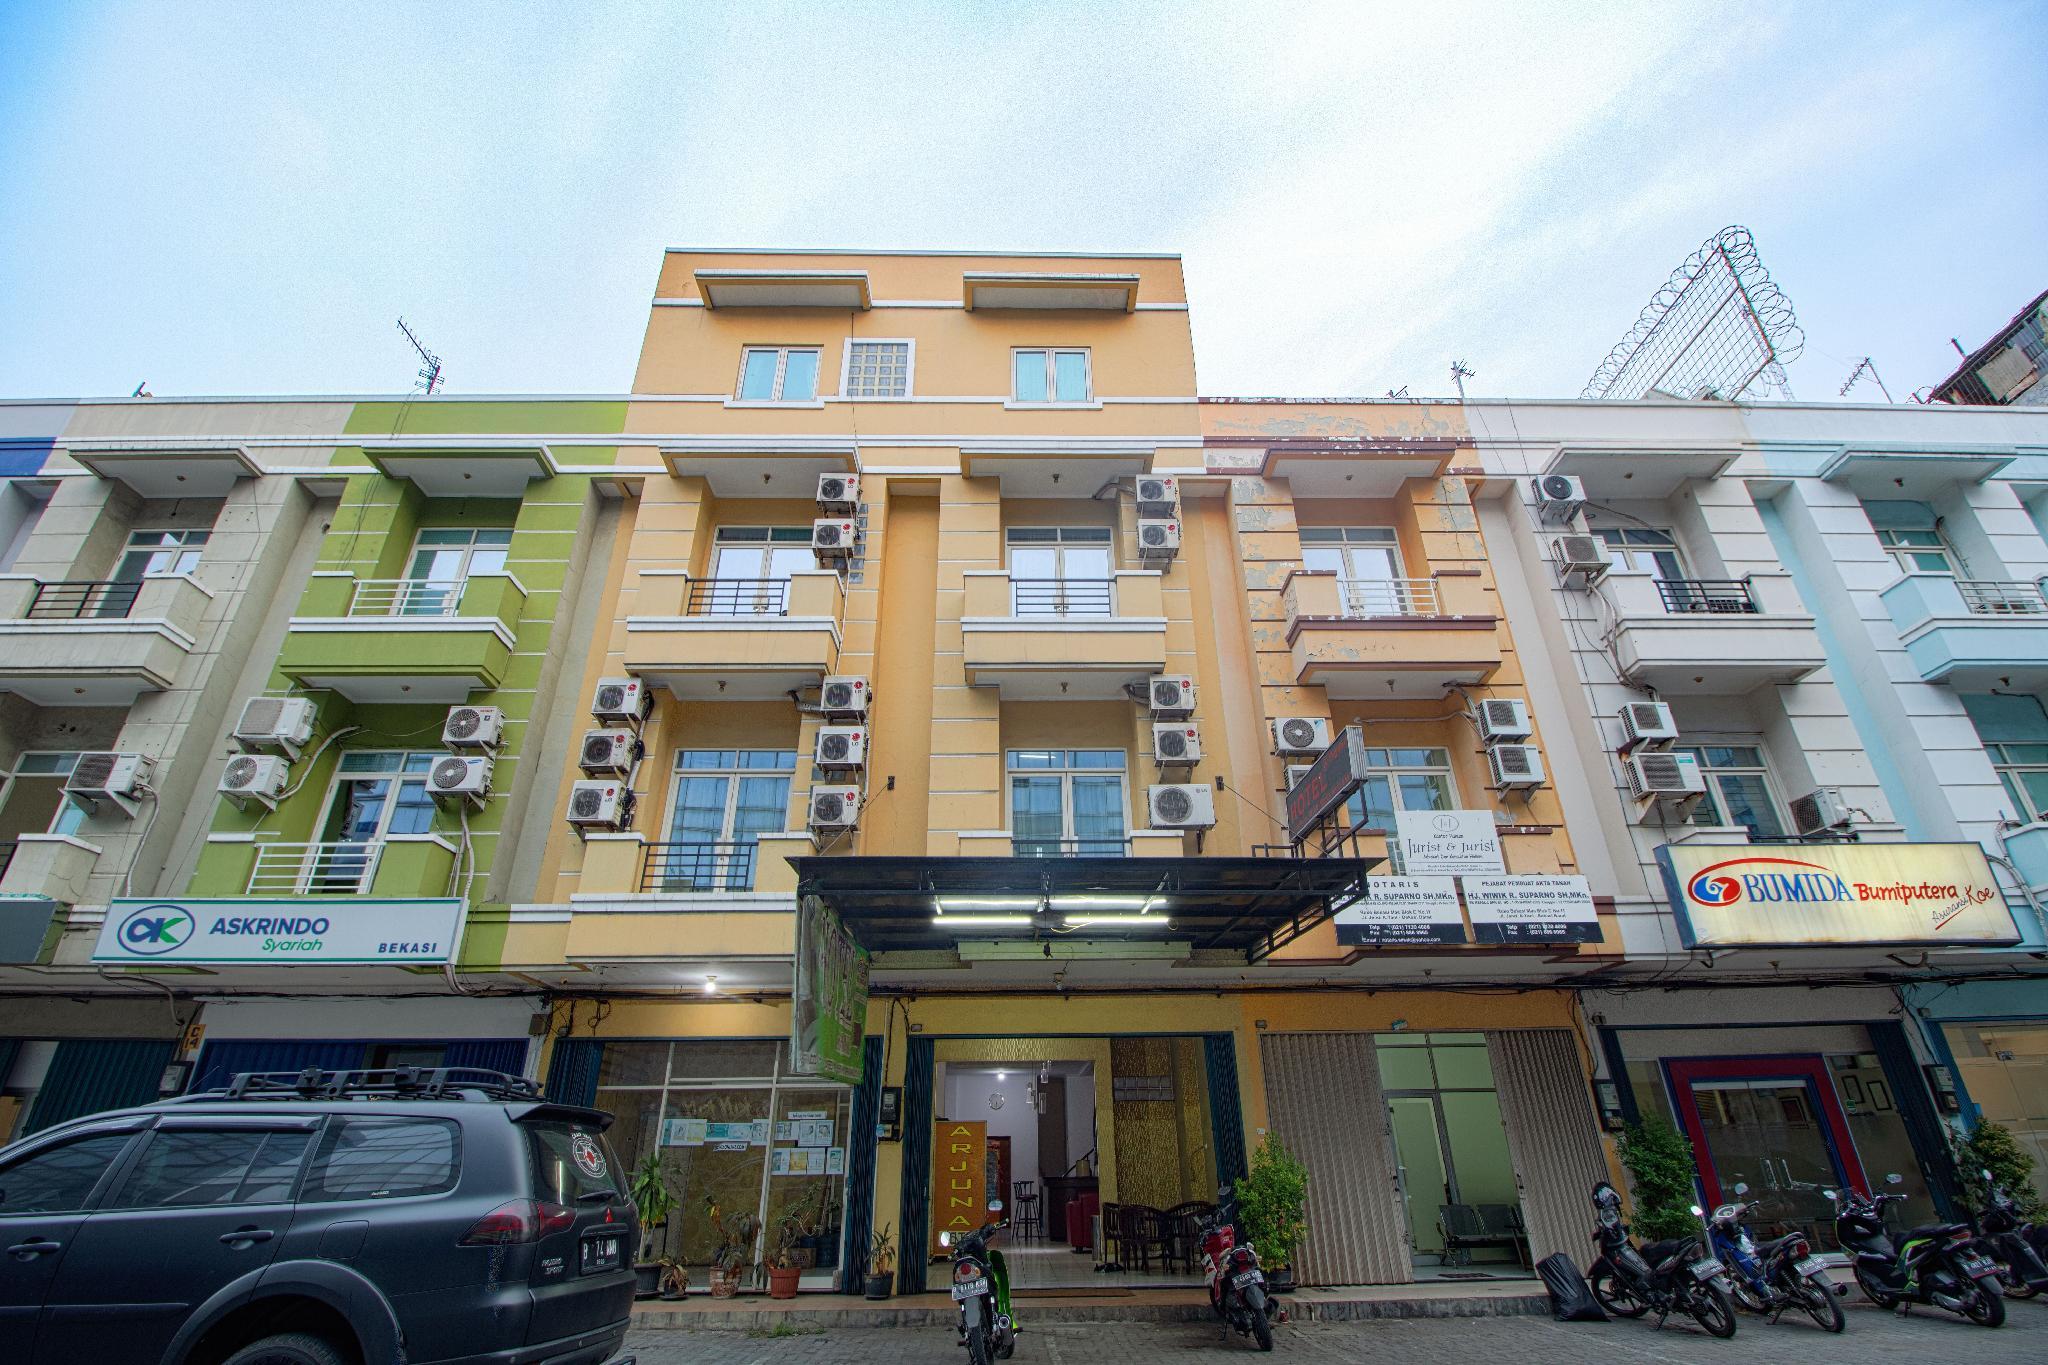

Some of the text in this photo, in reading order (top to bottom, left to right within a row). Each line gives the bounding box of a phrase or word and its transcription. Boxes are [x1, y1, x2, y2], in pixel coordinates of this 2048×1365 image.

[1408, 839, 1441, 858] Jurist
[1462, 839, 1495, 853] Jurist
[1383, 892, 1421, 900] SUPARNO
[1740, 873, 1855, 903] BUMIDA
[1853, 881, 1959, 906] Bumiputera
[1931, 897, 1969, 923] Asuransi
[209, 917, 329, 936] ASKRINDO
[262, 937, 323, 953] Syariah
[378, 943, 437, 953] BEKASI
[949, 1125, 974, 1227] ARJUNA
